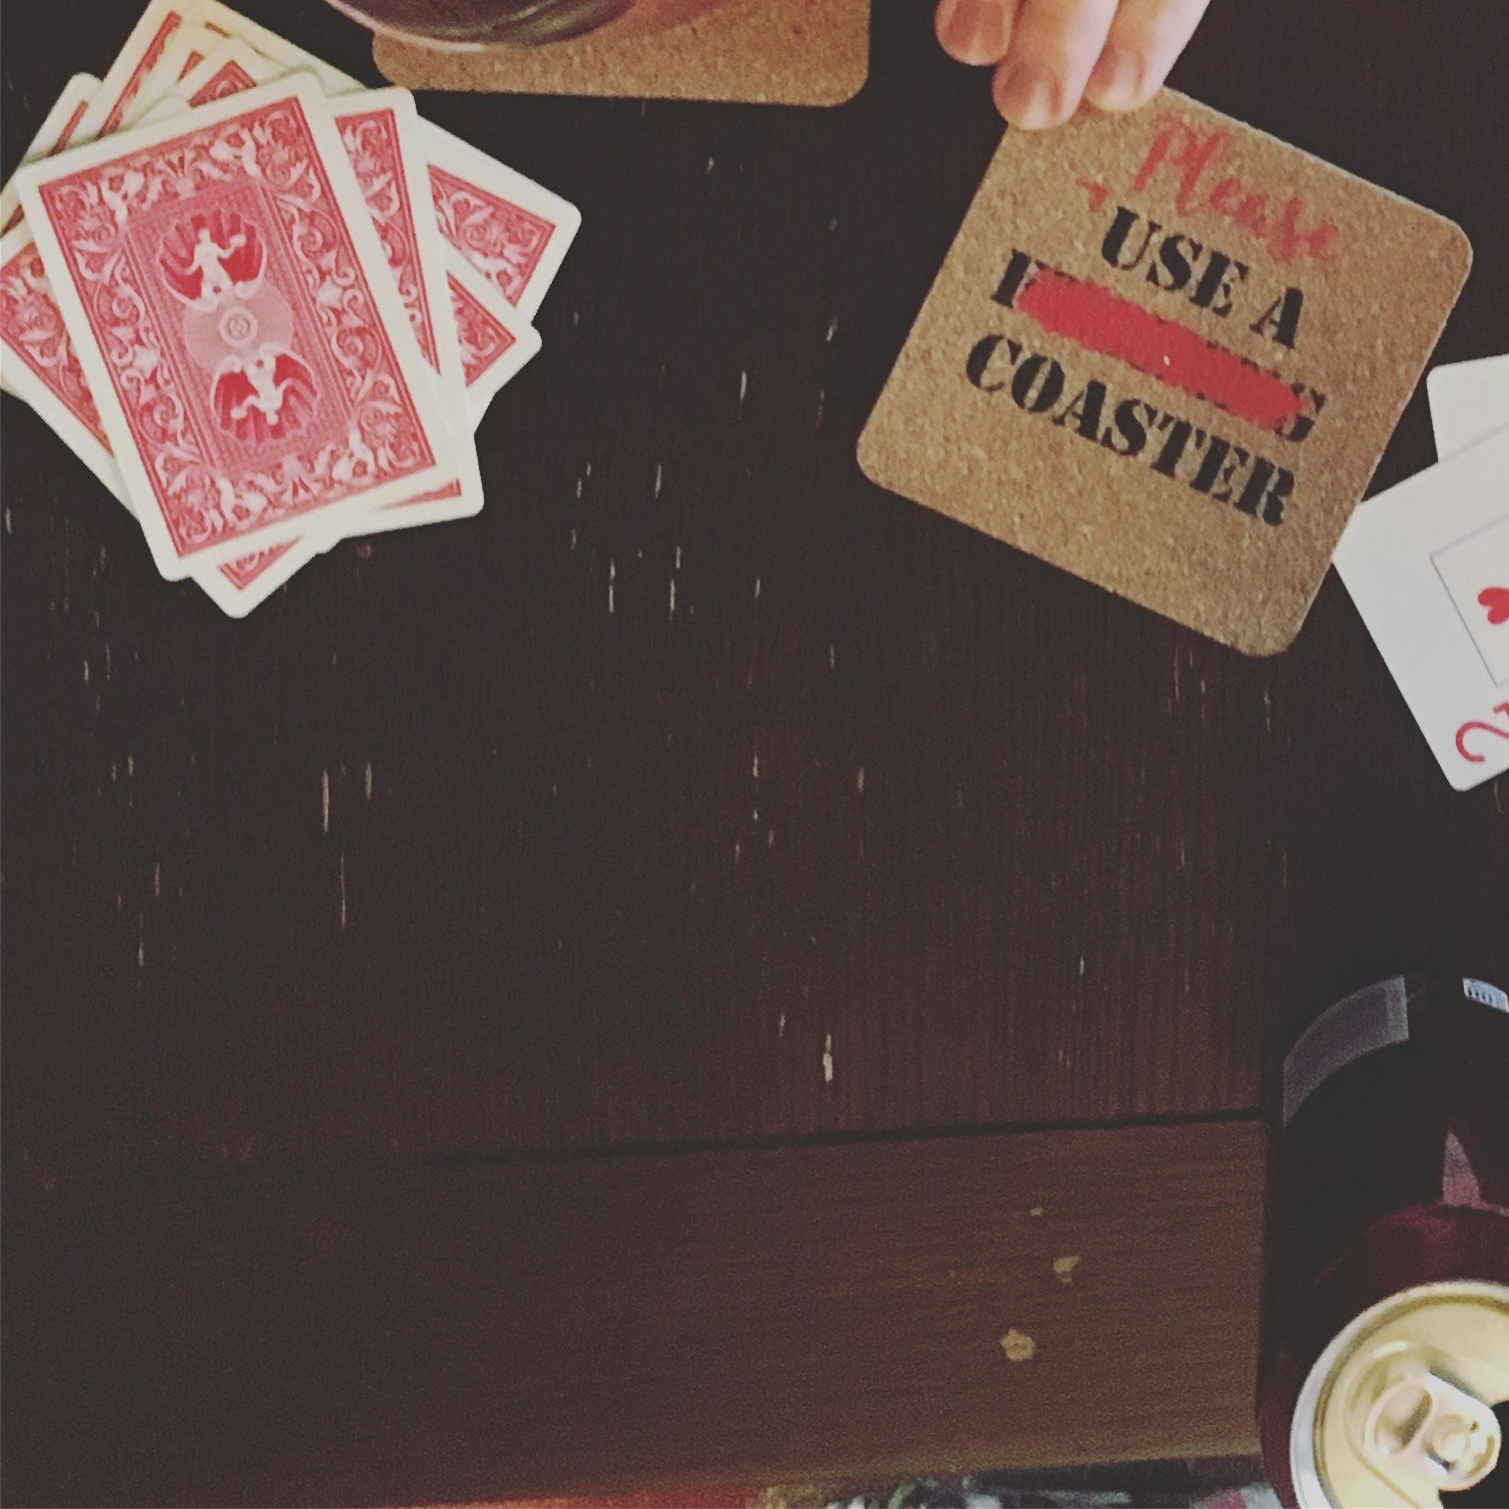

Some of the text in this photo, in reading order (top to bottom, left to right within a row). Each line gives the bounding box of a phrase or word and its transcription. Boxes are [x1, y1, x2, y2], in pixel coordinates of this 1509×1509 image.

[1131, 111, 1341, 265] Please
[1101, 205, 1249, 318] USE
[1249, 286, 1304, 351] A
[965, 334, 1296, 528] COASTER
